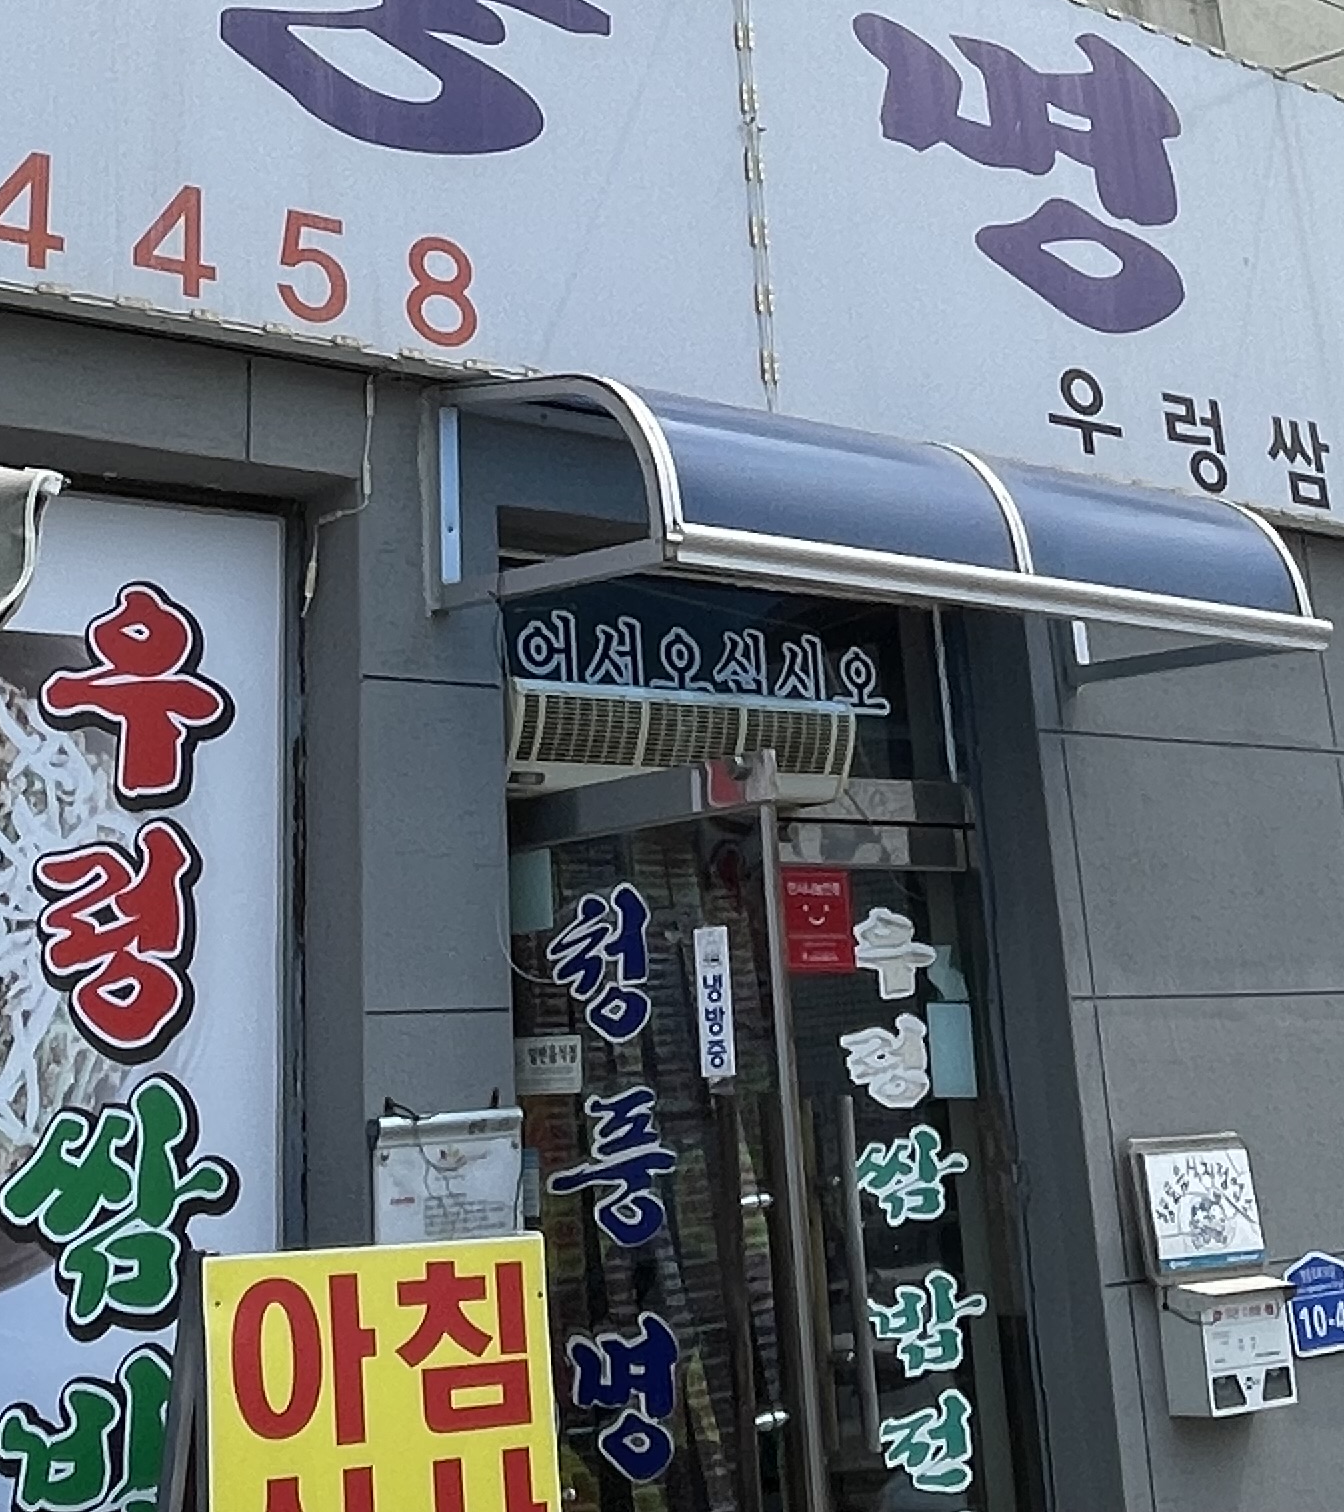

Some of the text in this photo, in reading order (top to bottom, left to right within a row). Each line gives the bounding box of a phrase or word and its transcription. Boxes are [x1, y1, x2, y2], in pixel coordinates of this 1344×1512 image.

[517, 611, 891, 716] 어서오십시오
[702, 974, 728, 1069] 냉방중
[231, 1259, 534, 1446] 아침
